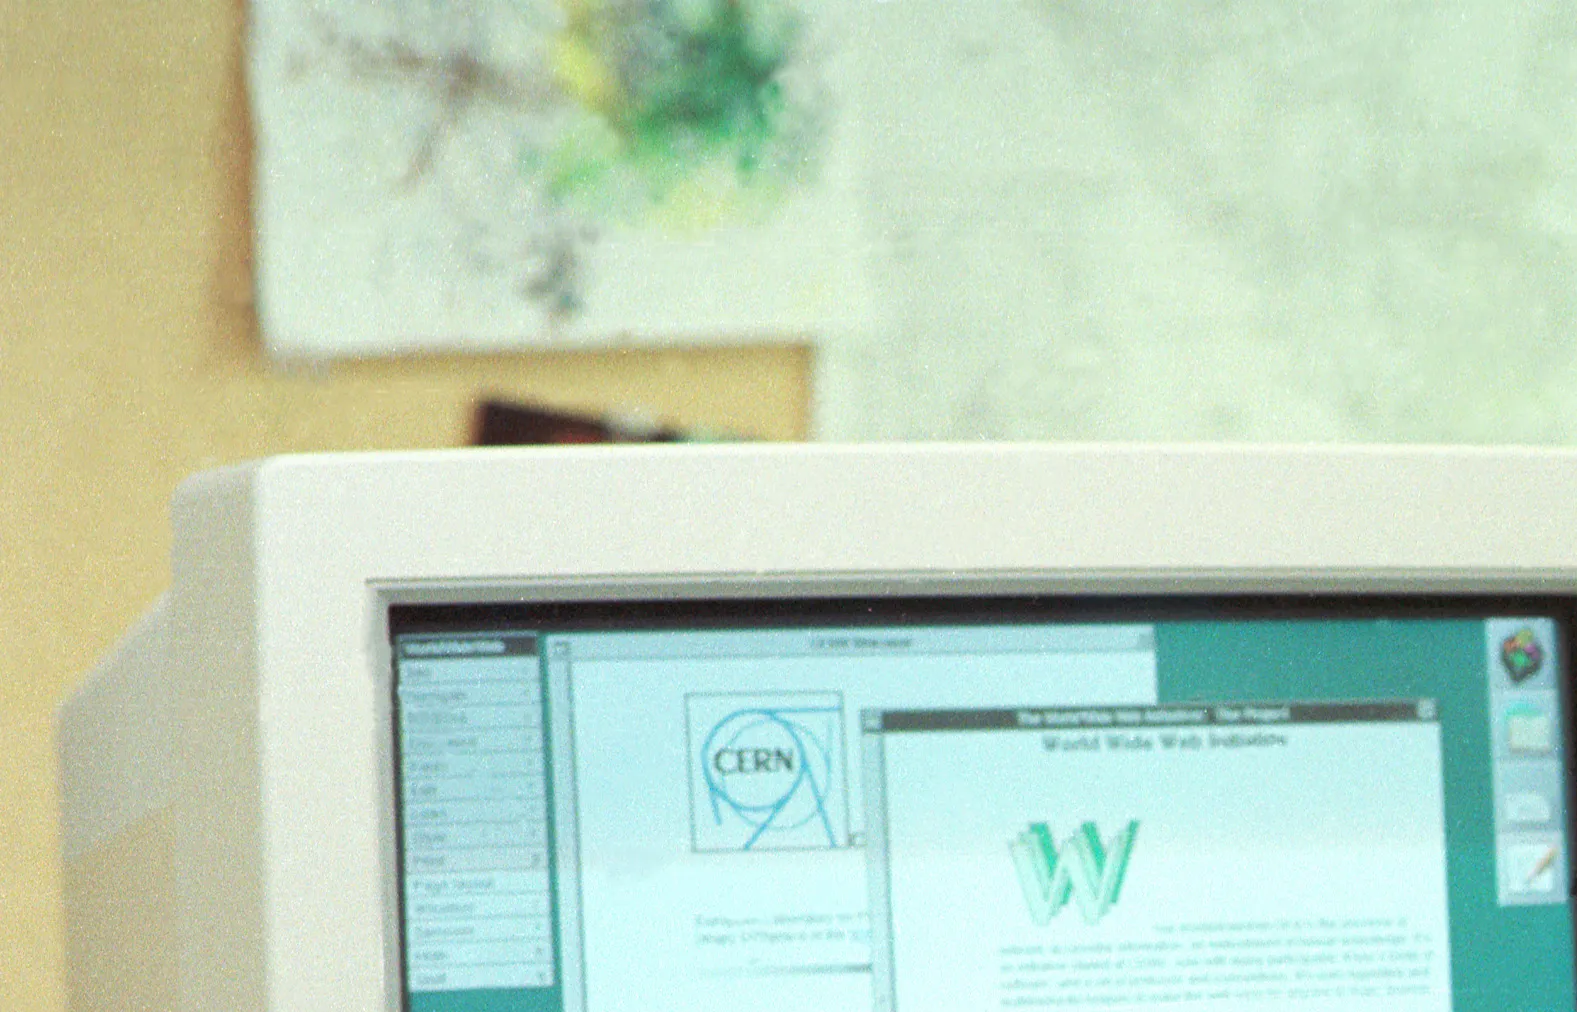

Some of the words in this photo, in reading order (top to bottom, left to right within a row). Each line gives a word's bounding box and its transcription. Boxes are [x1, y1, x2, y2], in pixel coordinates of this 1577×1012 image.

[1042, 733, 1101, 752] World
[1105, 732, 1153, 751] Wide
[1156, 731, 1203, 749] Web
[1209, 730, 1289, 749] Initiative
[714, 748, 795, 775] CERN
